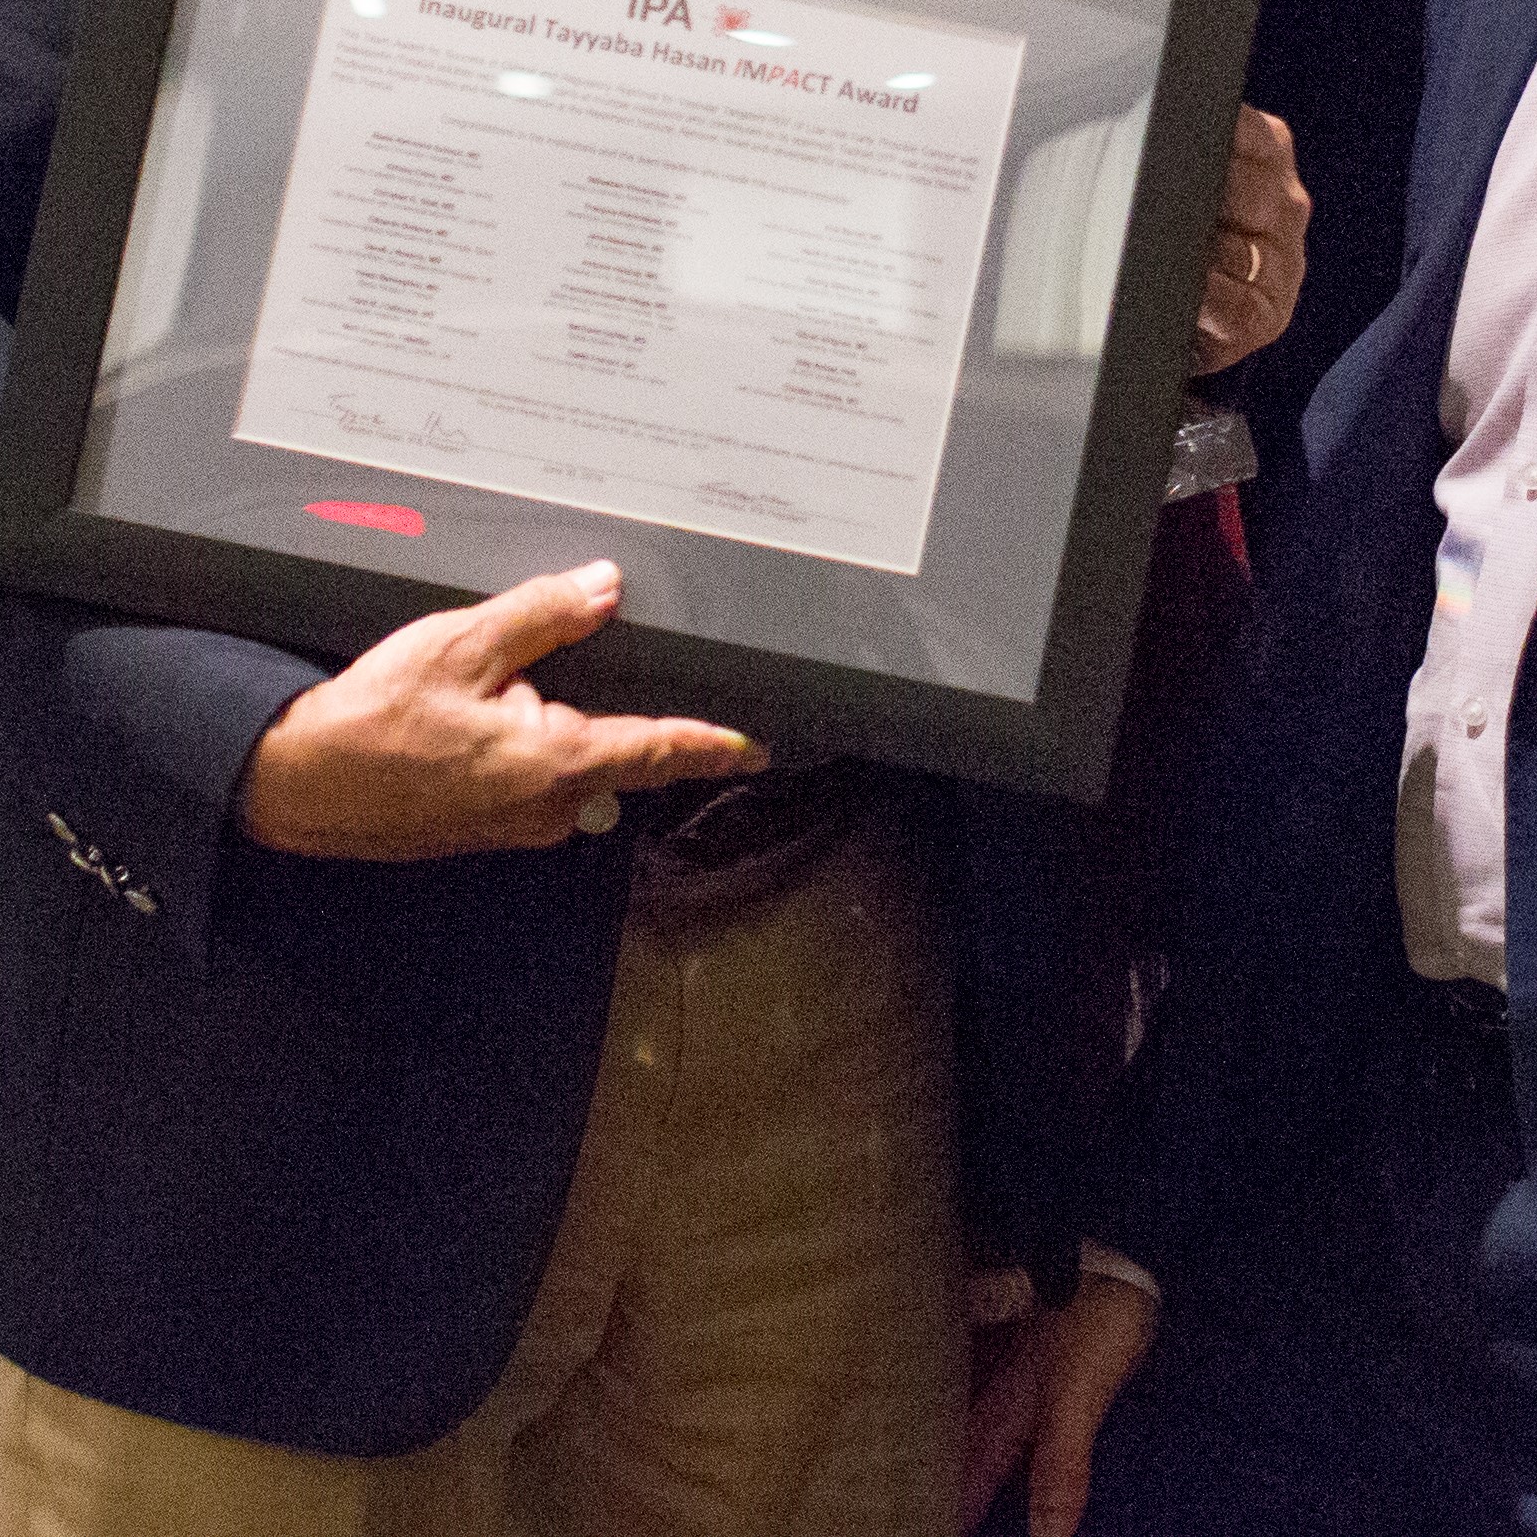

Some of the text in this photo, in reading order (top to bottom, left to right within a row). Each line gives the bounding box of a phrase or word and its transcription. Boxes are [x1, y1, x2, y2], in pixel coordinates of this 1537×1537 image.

[545, 19, 644, 59] Tayyaba
[653, 41, 727, 74] Hasan
[733, 57, 833, 95] IMPACT
[837, 80, 921, 115] Award
